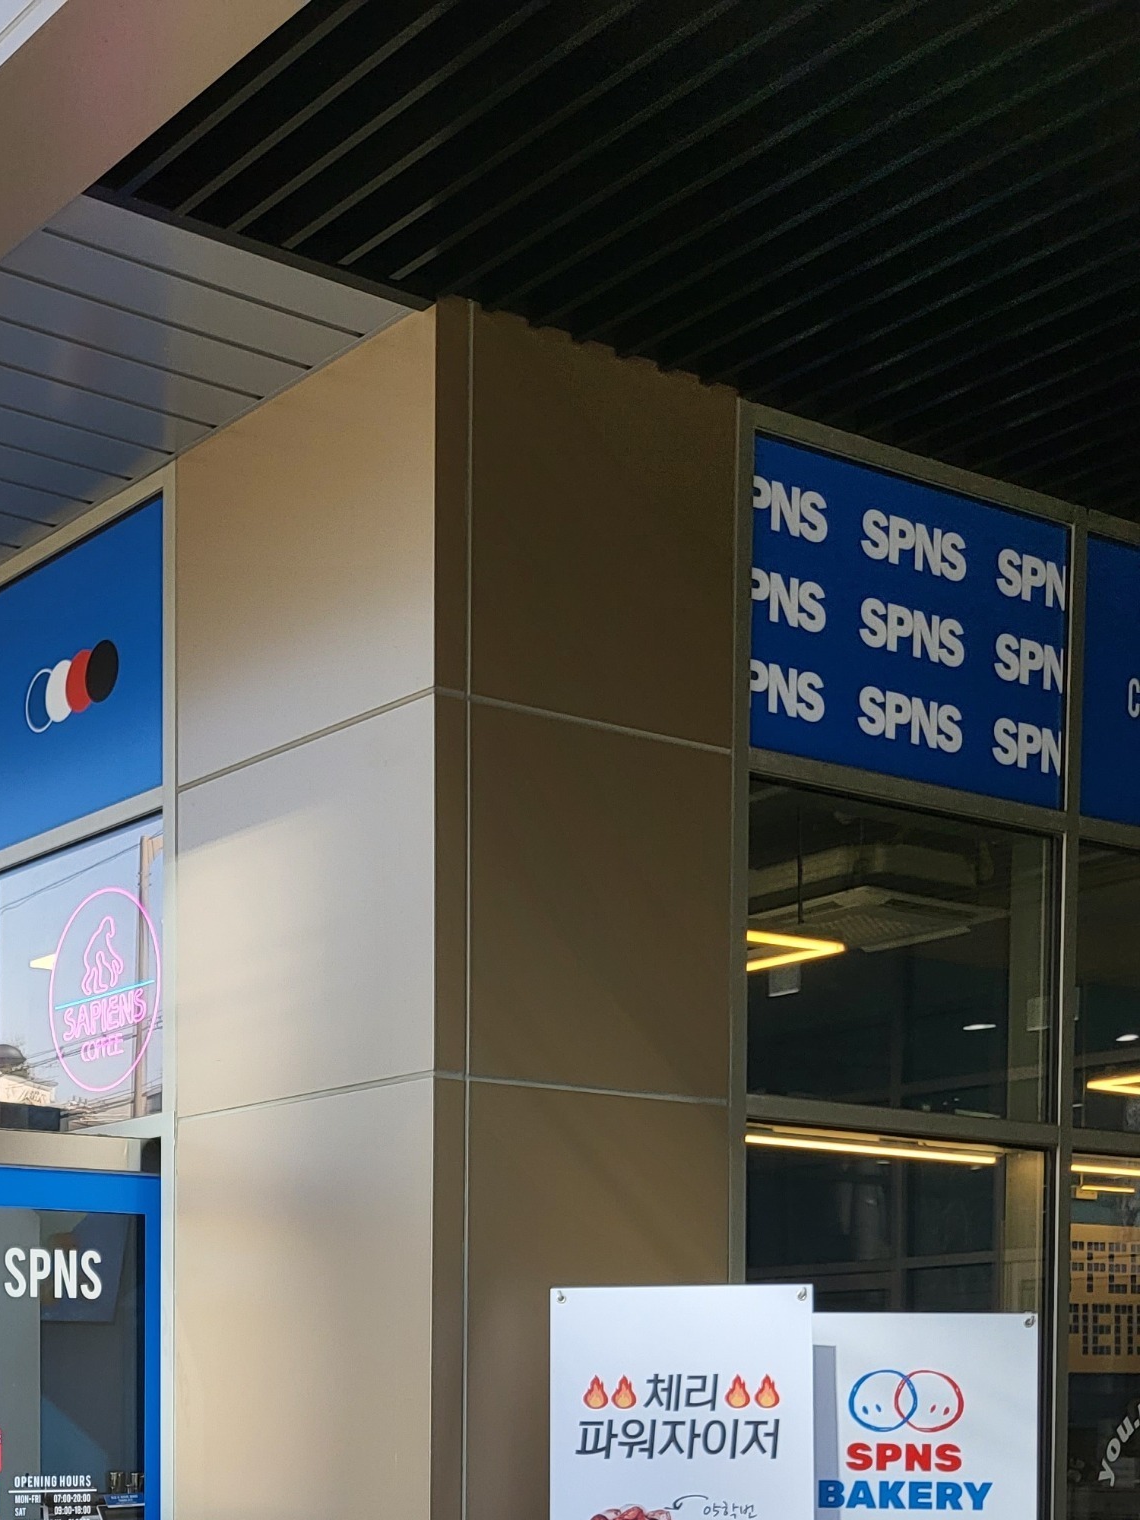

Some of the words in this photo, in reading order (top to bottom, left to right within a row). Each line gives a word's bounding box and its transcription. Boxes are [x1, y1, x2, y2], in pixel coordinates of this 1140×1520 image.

[861, 508, 966, 582] SPNS
[859, 597, 965, 668] SPNS
[857, 685, 963, 753] SPNS
[63, 988, 147, 1041] SAPIENS
[81, 1033, 124, 1062] COFFEE
[4, 1247, 102, 1300] SPNS
[643, 1373, 719, 1411] 체리
[575, 1418, 780, 1460] 파워자이저
[846, 1442, 962, 1472] SPNS
[14, 1475, 57, 1488] OPENING
[60, 1475, 92, 1487] HOURS
[14, 1495, 42, 1503] MON-FRI
[54, 1494, 91, 1503] 07:00-20:00
[818, 1480, 993, 1511] BAKERY
[14, 1508, 26, 1516] SAT
[703, 1501, 757, 1520] 05학번
